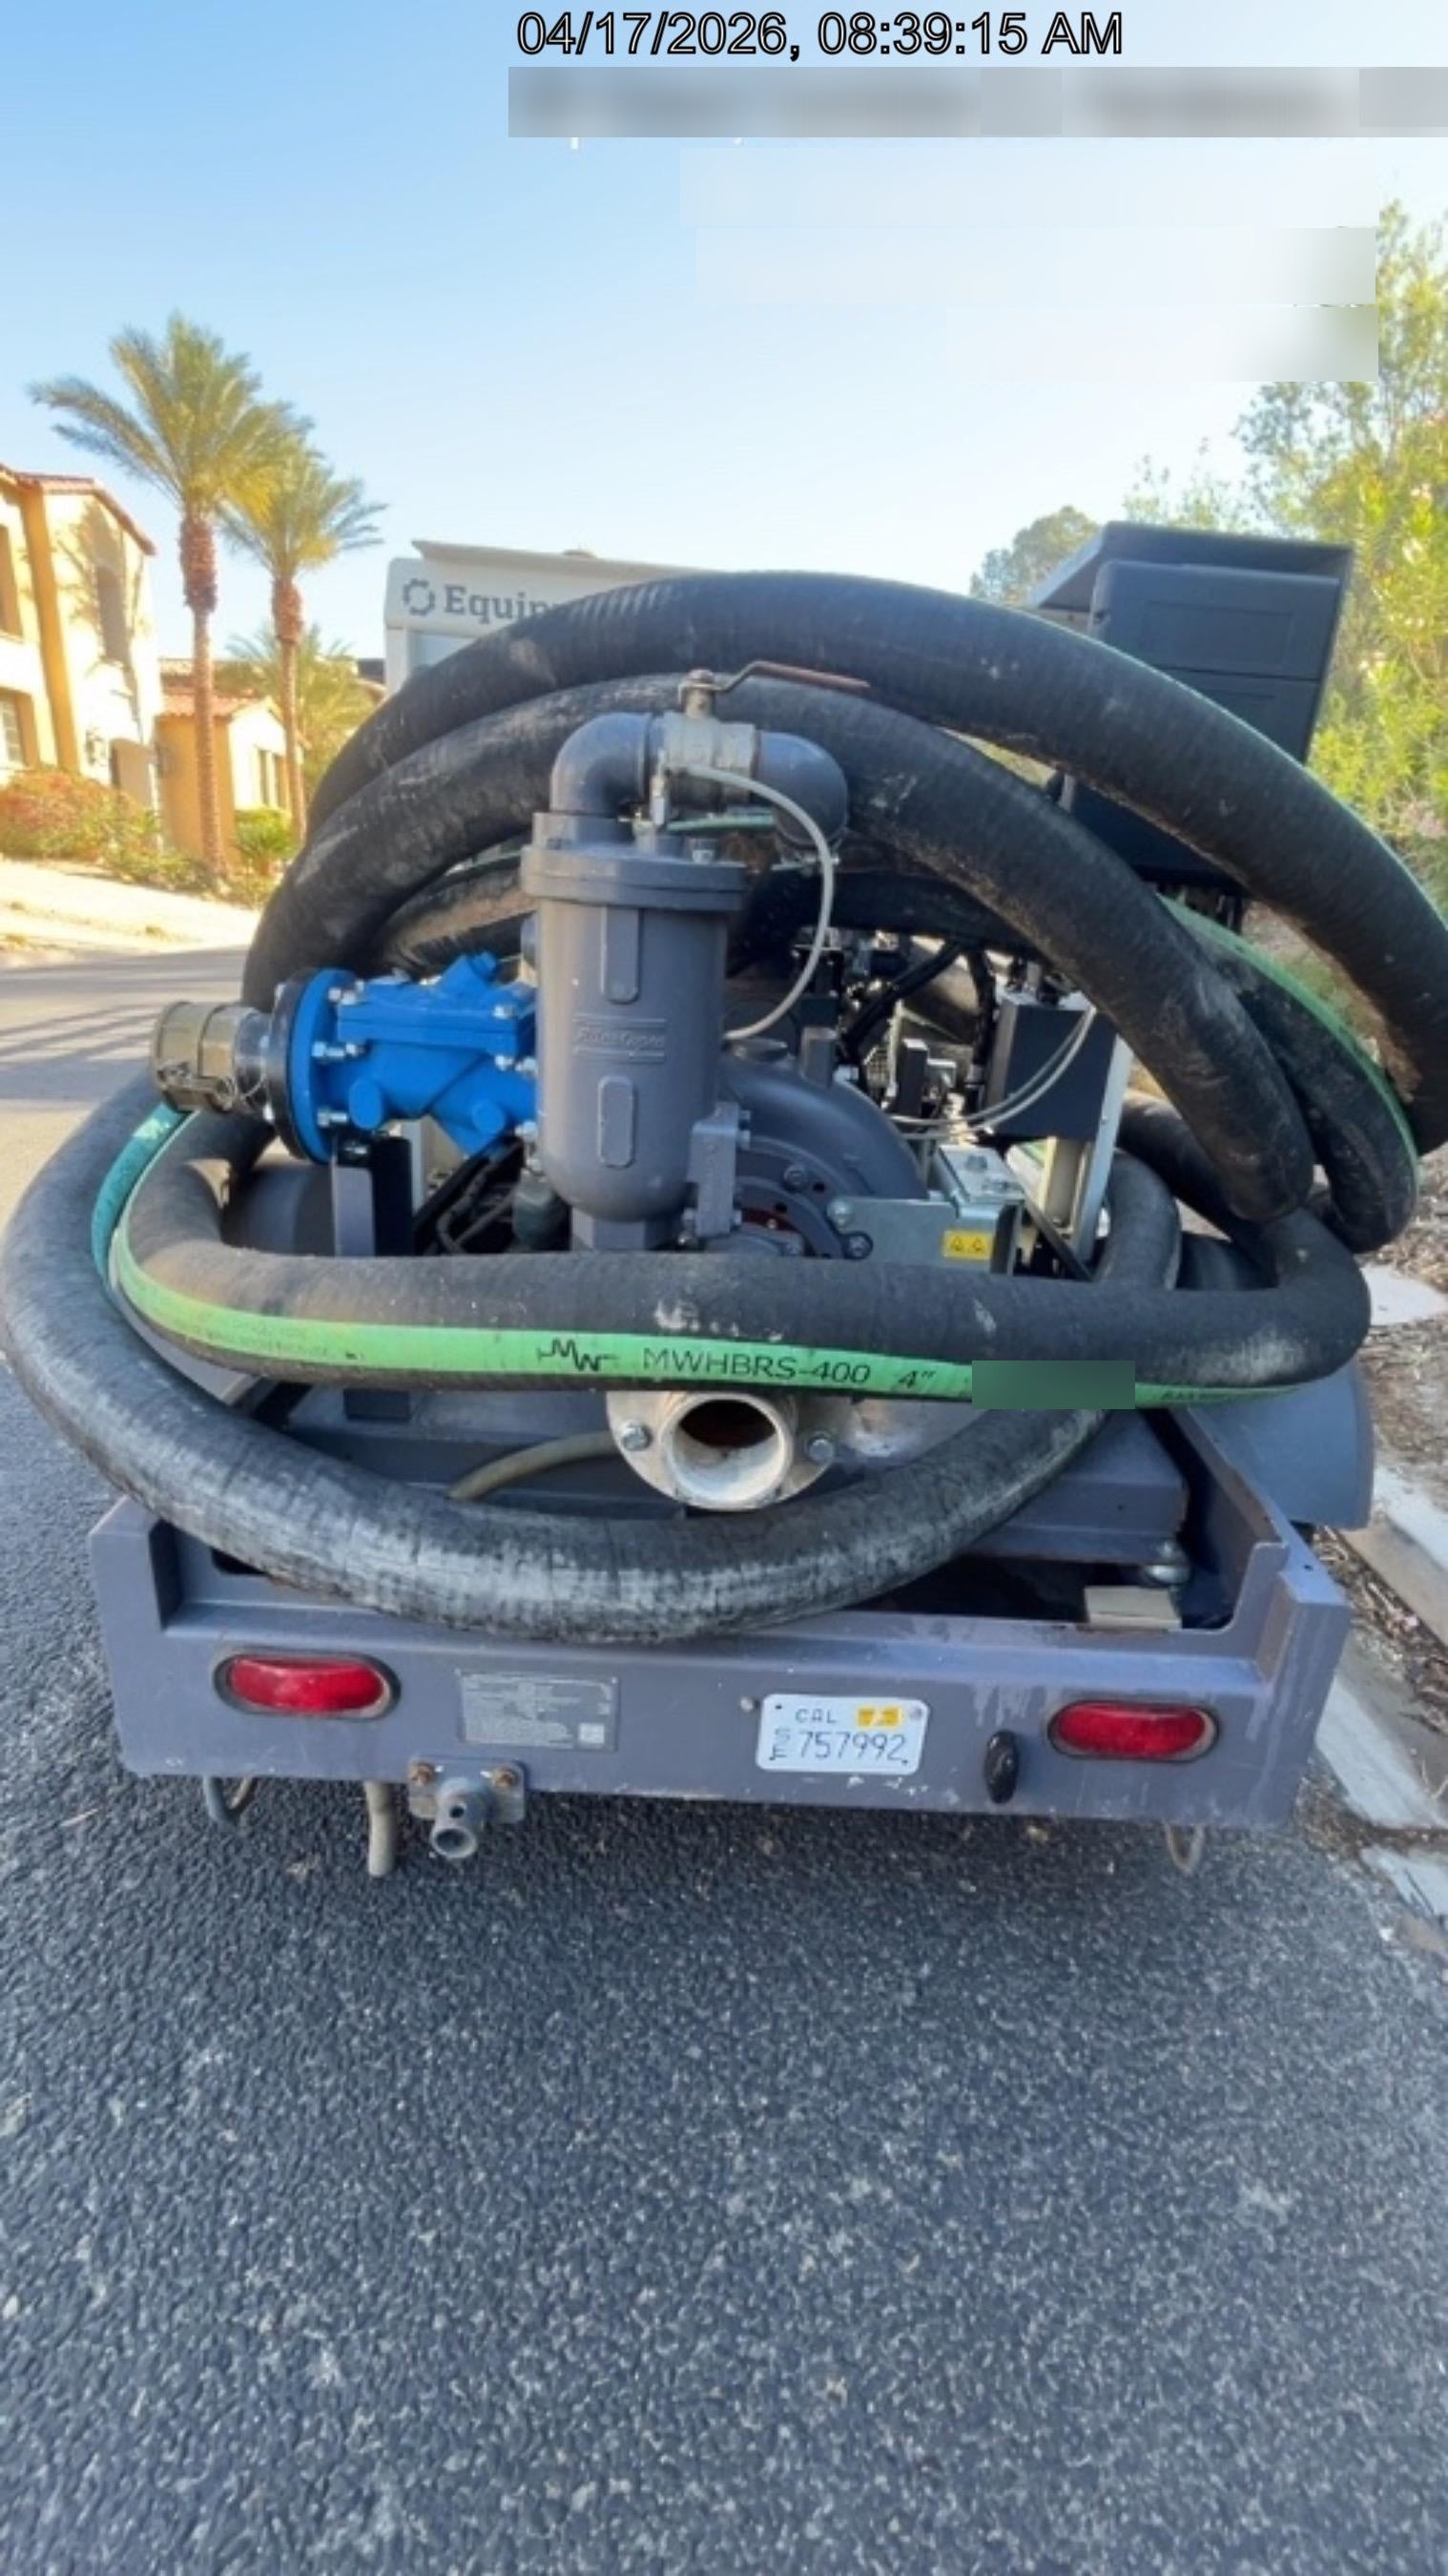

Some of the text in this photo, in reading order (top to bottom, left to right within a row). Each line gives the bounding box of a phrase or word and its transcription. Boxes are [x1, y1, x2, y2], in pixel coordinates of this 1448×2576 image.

[643, 1347, 871, 1384] MWHBRS-400
[795, 1708, 838, 1724] CAL
[797, 1731, 906, 1761] 757992
